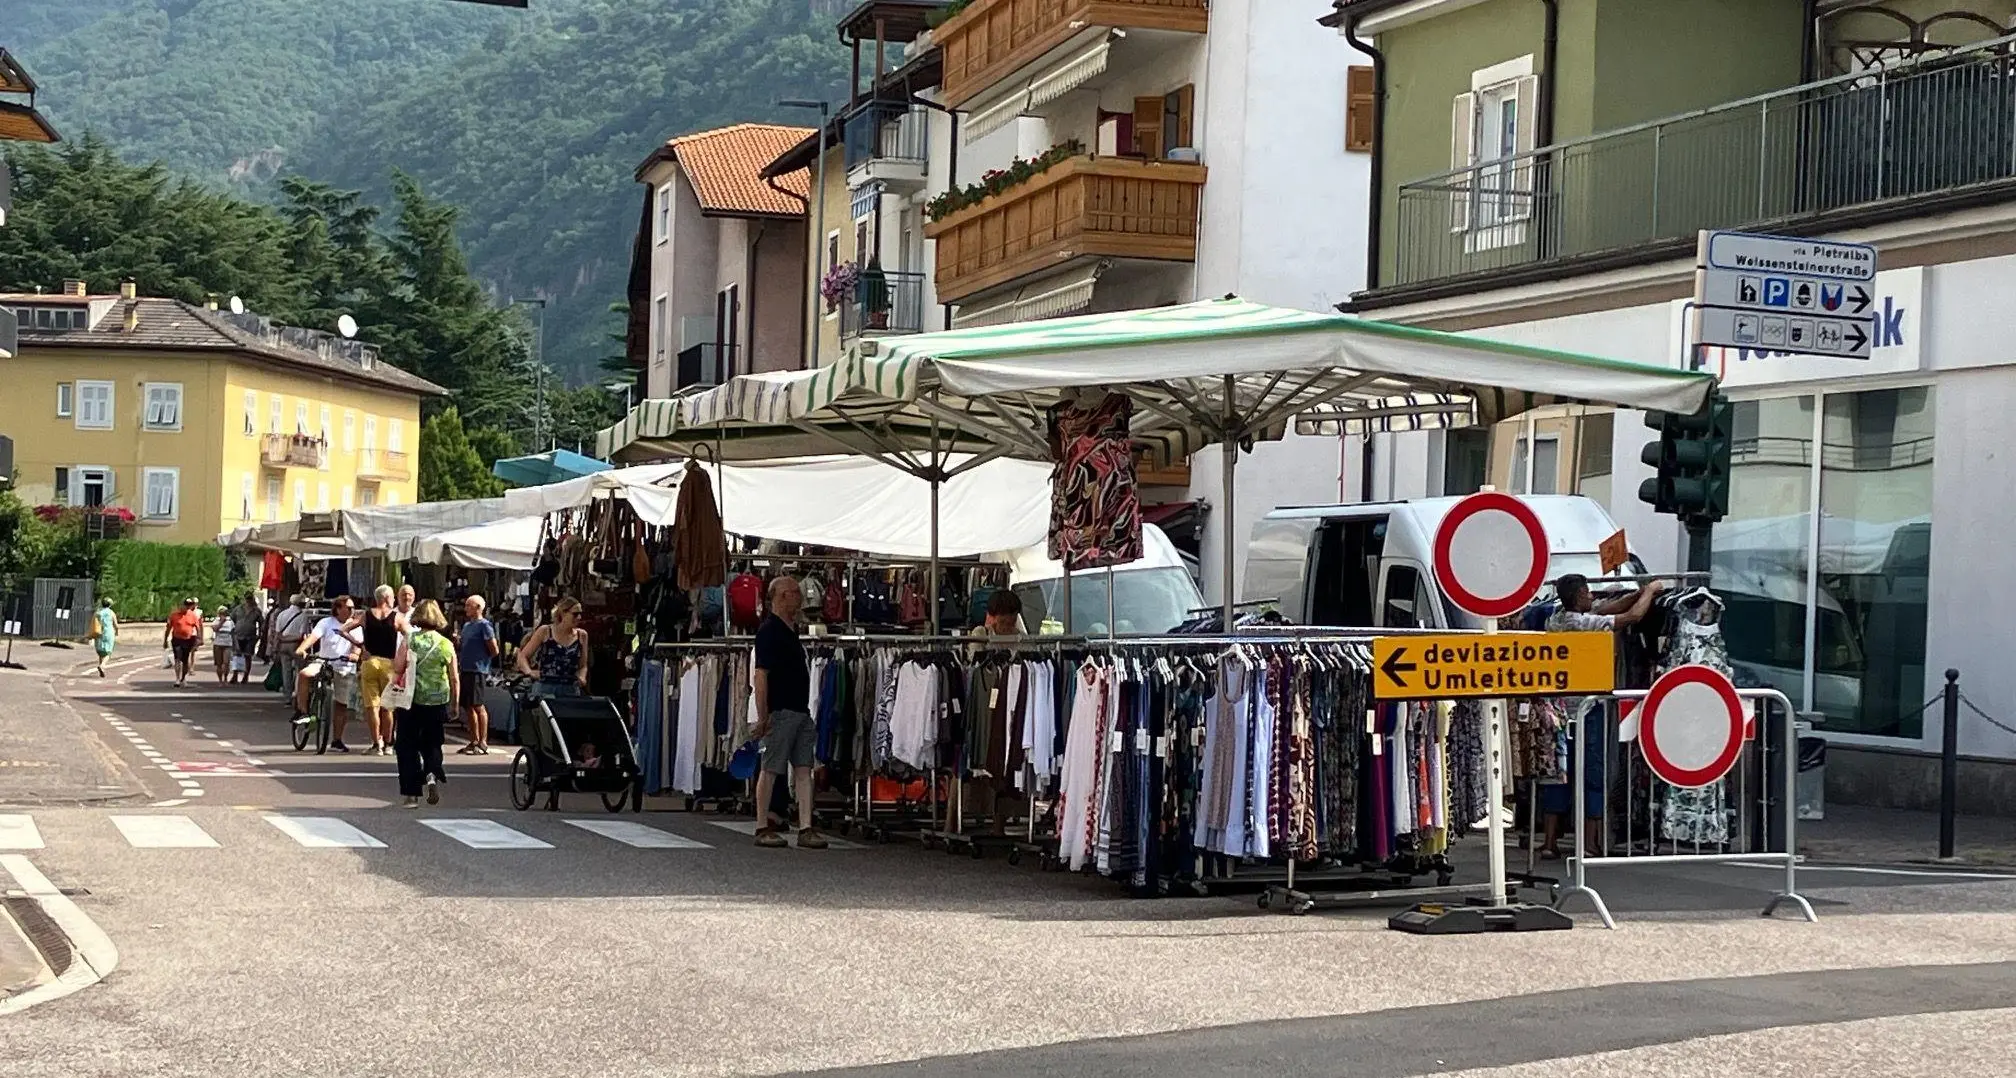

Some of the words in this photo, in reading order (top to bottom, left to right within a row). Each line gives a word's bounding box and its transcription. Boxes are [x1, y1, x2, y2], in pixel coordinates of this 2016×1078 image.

[1813, 245, 1869, 261] Pietralba
[1736, 254, 1868, 277] Weissensteinerstraße
[1768, 281, 1785, 304] P
[1424, 641, 1569, 663] deviazione
[1424, 668, 1569, 690] Umleitung
